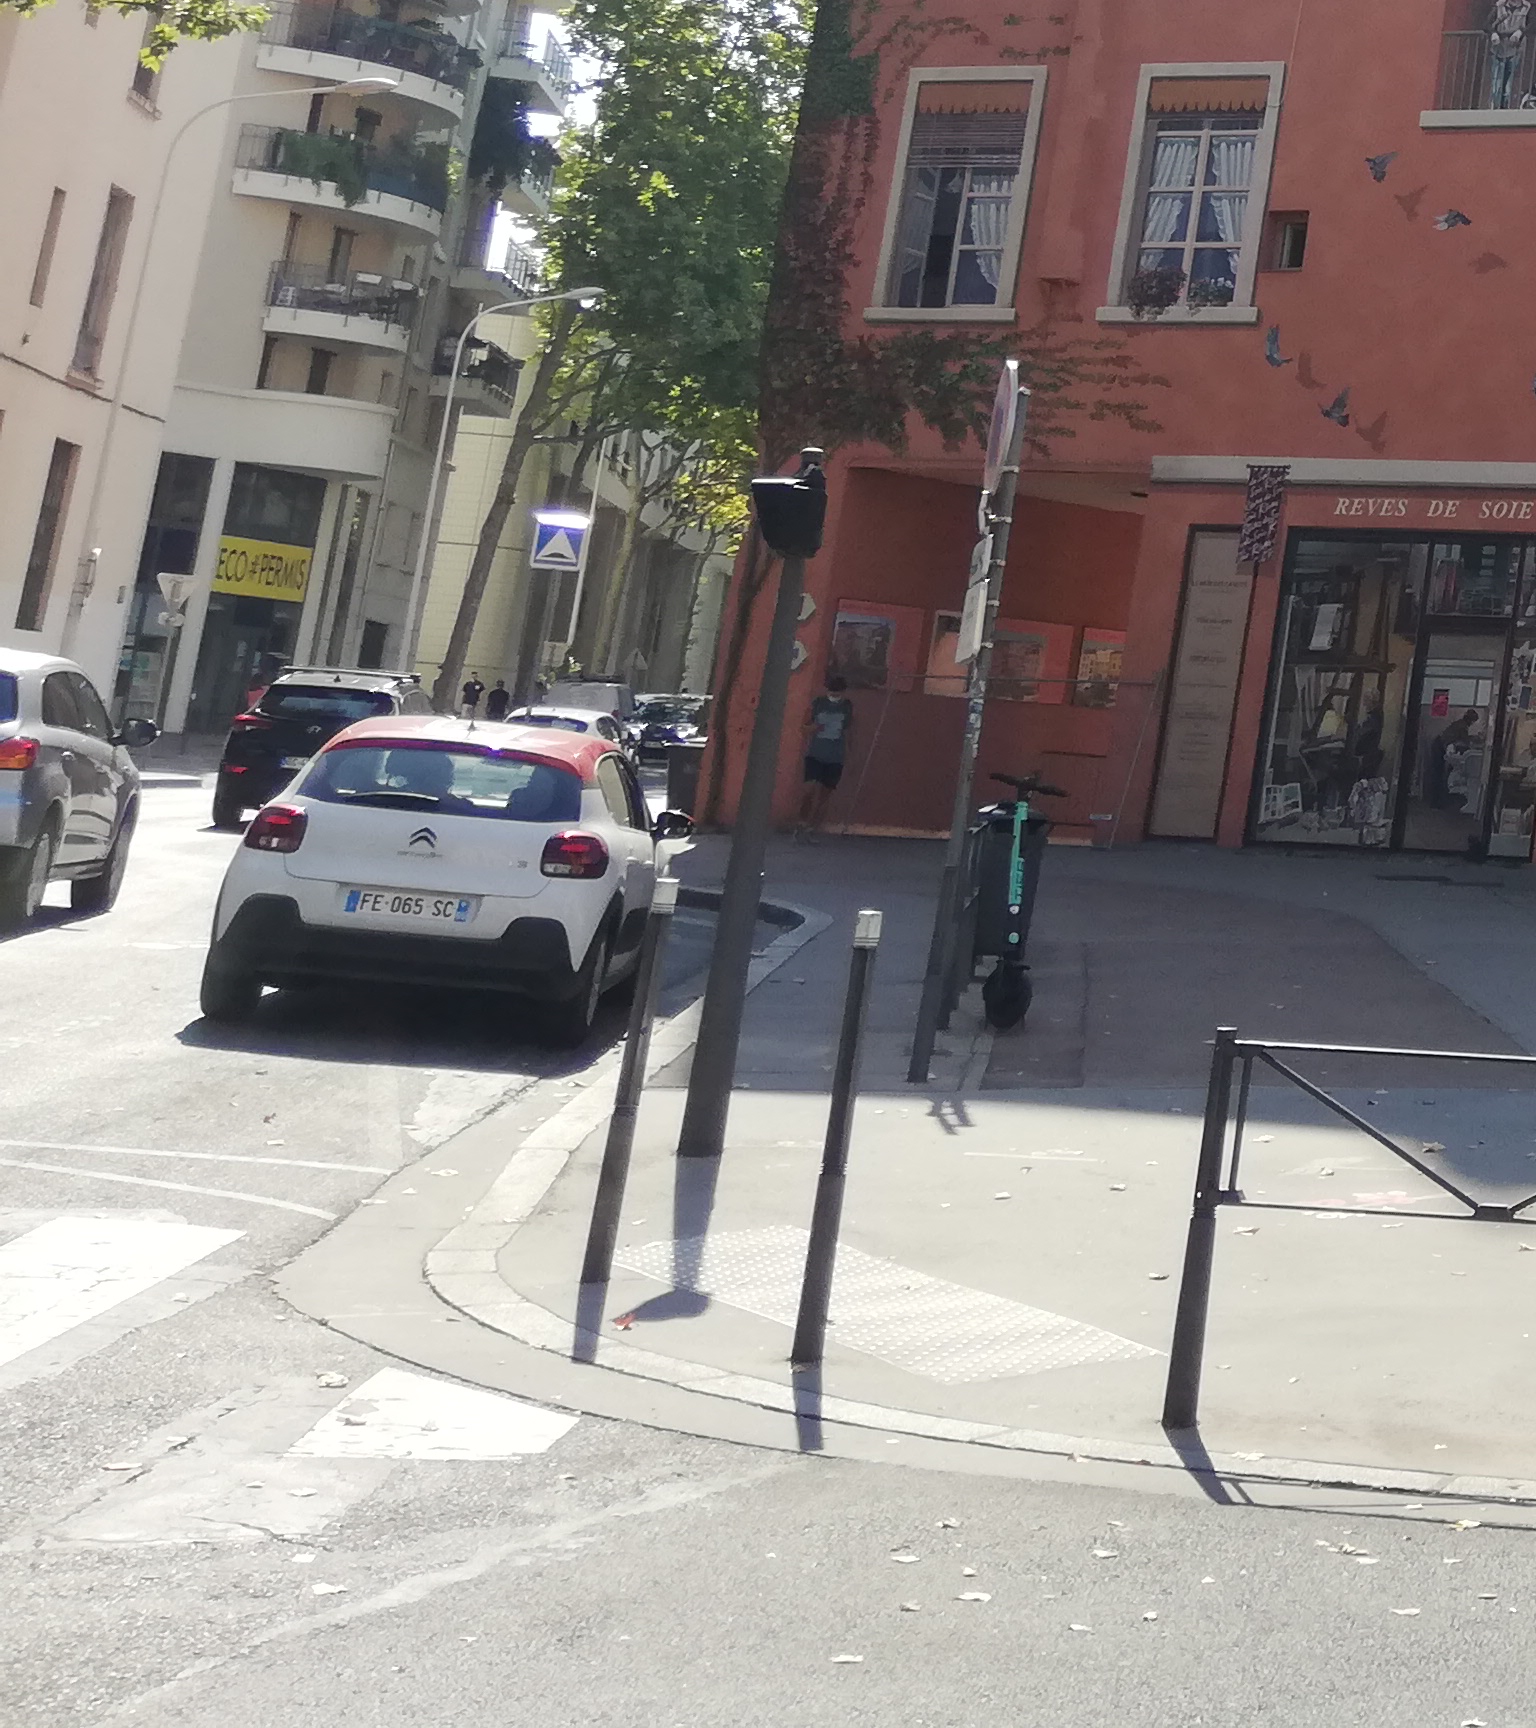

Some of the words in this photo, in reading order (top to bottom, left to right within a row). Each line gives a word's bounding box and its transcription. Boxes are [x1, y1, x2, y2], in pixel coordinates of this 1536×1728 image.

[1333, 497, 1409, 517] REVES
[1426, 499, 1460, 518] DE
[1478, 499, 1535, 519] SOIE
[215, 547, 249, 582] ECO
